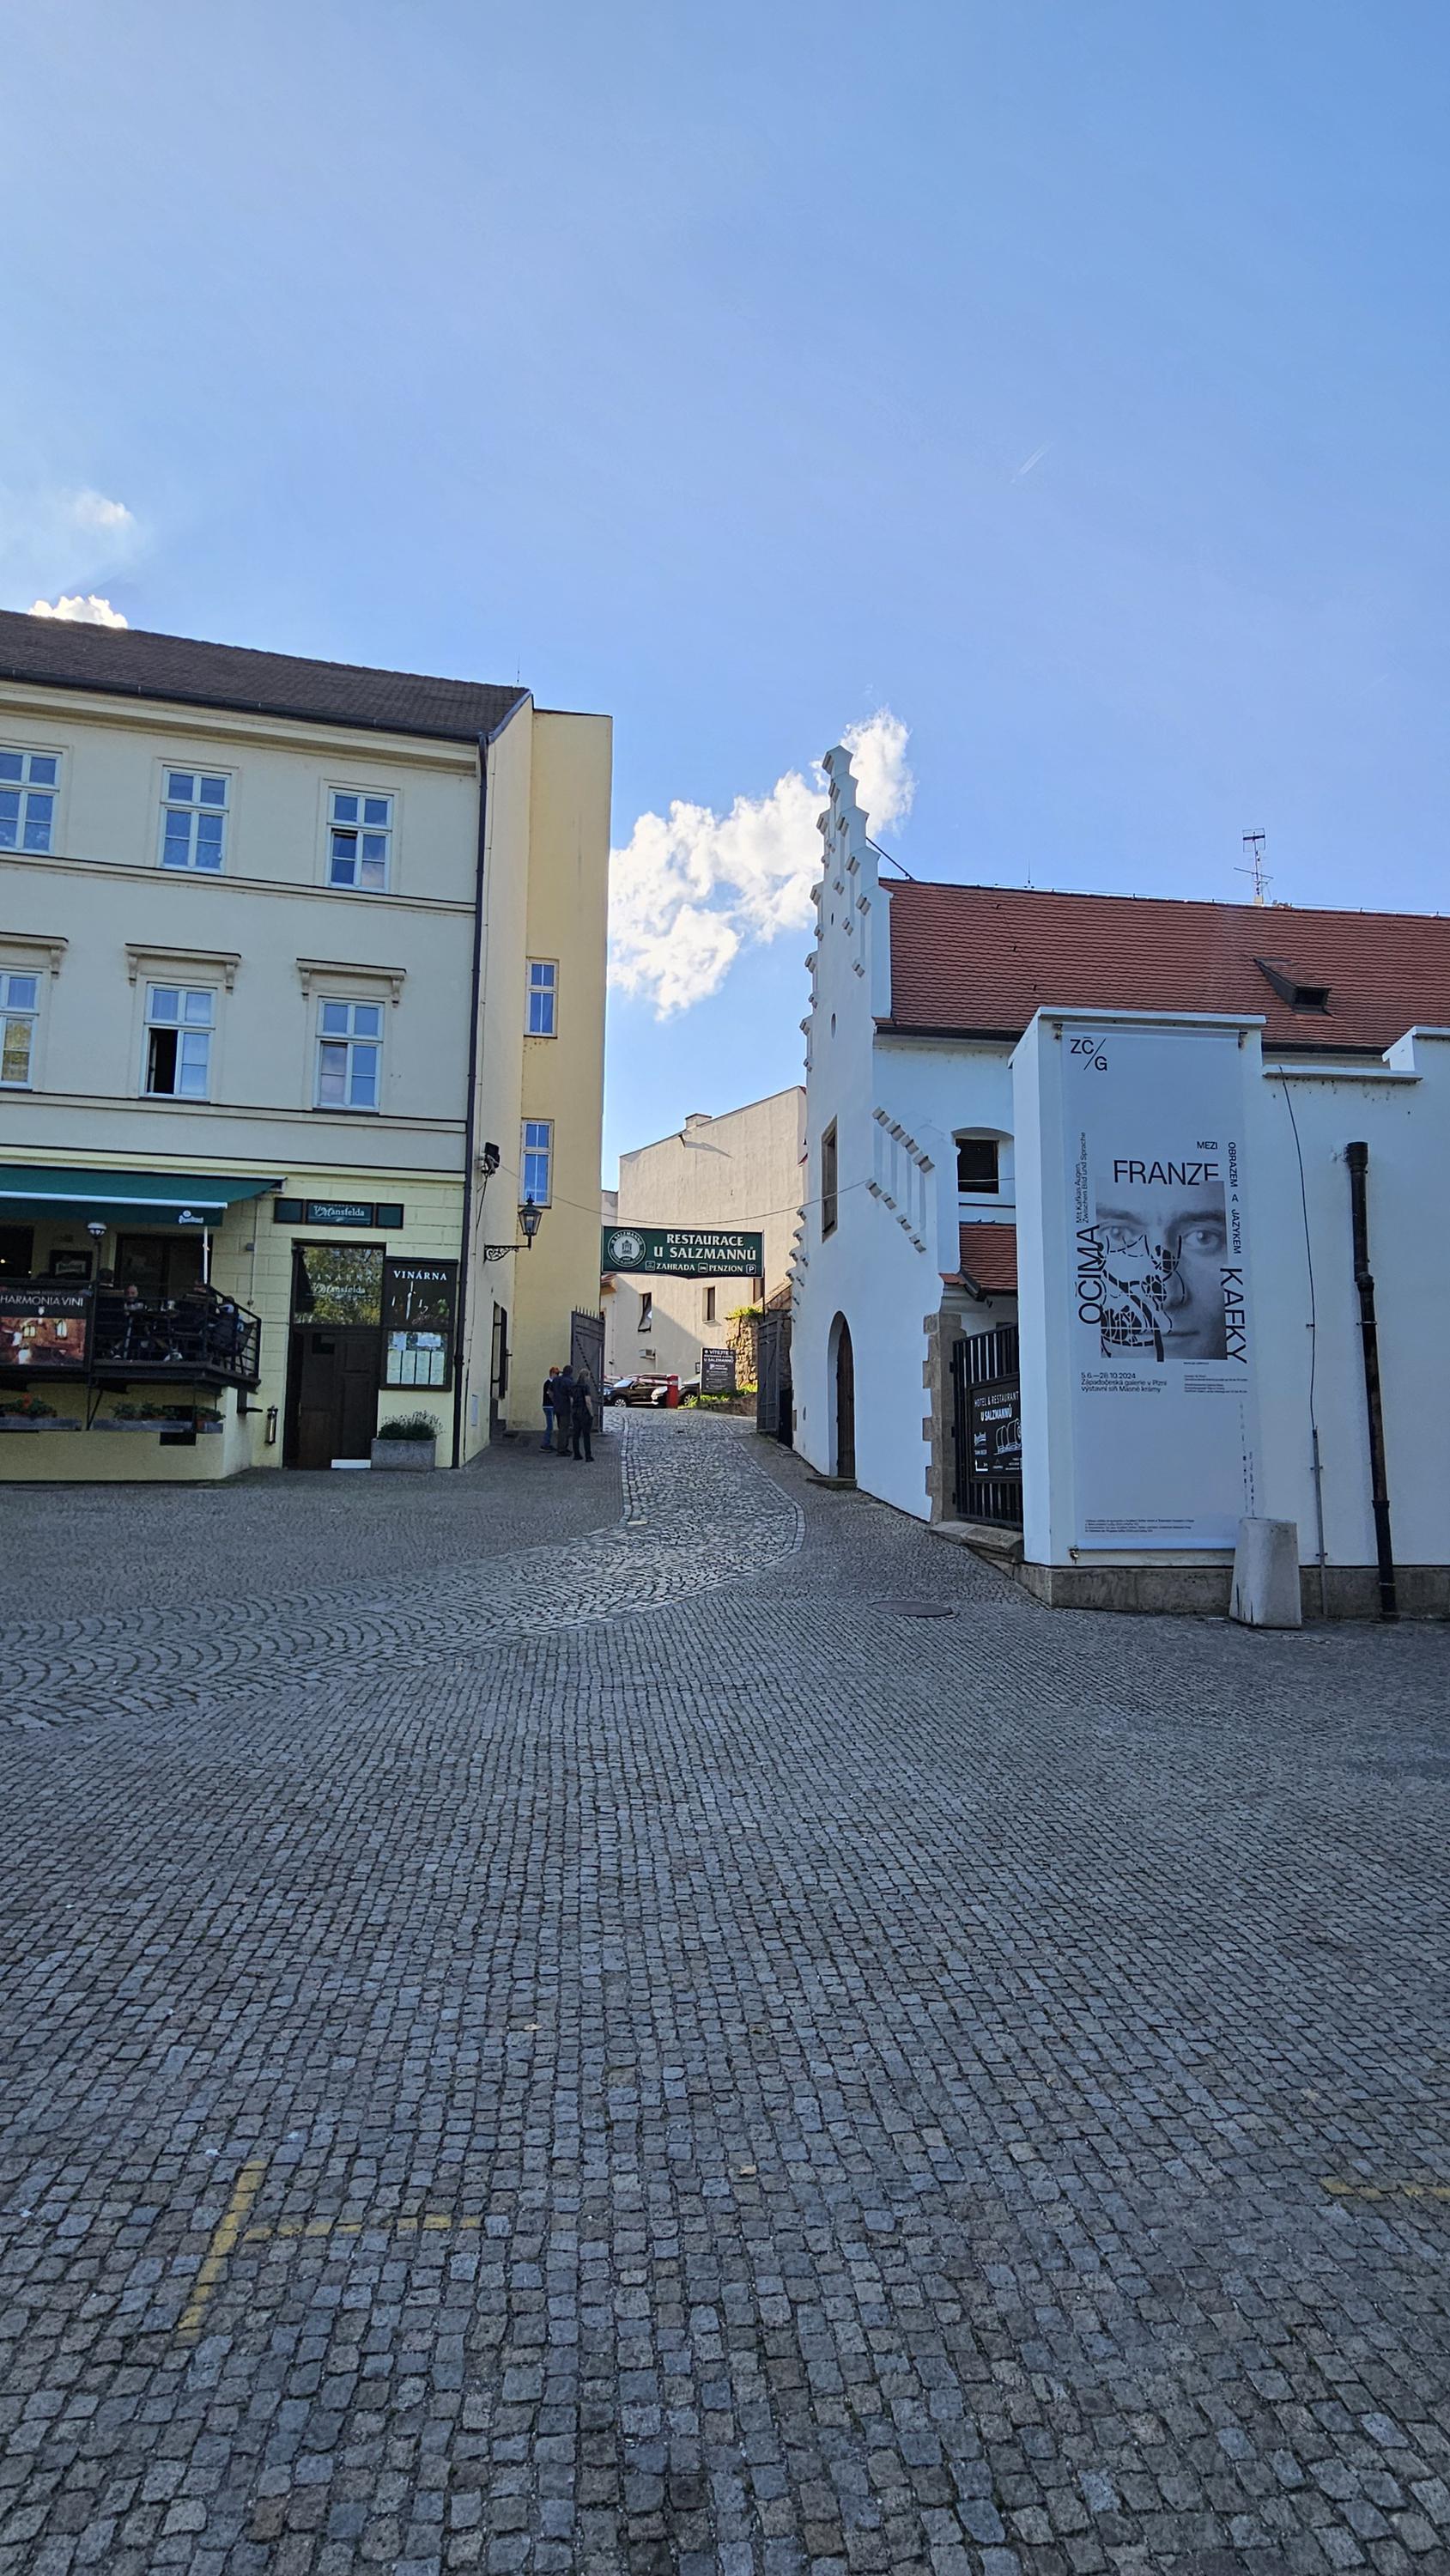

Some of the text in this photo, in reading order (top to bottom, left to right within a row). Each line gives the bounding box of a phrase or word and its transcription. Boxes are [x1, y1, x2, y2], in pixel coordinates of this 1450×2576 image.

[1197, 1141, 1217, 1150] MEZI
[1228, 1141, 1241, 1255] OBRAZEM A JAZYKEM
[321, 1206, 365, 1217] Mansfelda
[666, 1233, 744, 1246] RESTAURACE
[653, 1246, 663, 1257] U
[670, 1246, 756, 1261] SALZMANNŮ
[656, 1262, 695, 1271] ZAHRADA
[708, 1264, 743, 1273] PENZION
[393, 1270, 447, 1280] VINÁRNA
[1074, 1224, 1102, 1324] OČIMA
[62, 1297, 83, 1307] VINI
[1219, 1267, 1247, 1364] KAFKY
[974, 1397, 987, 1407] HOTEL
[991, 1391, 1019, 1405] RESTAURANT
[980, 1411, 985, 1422] U
